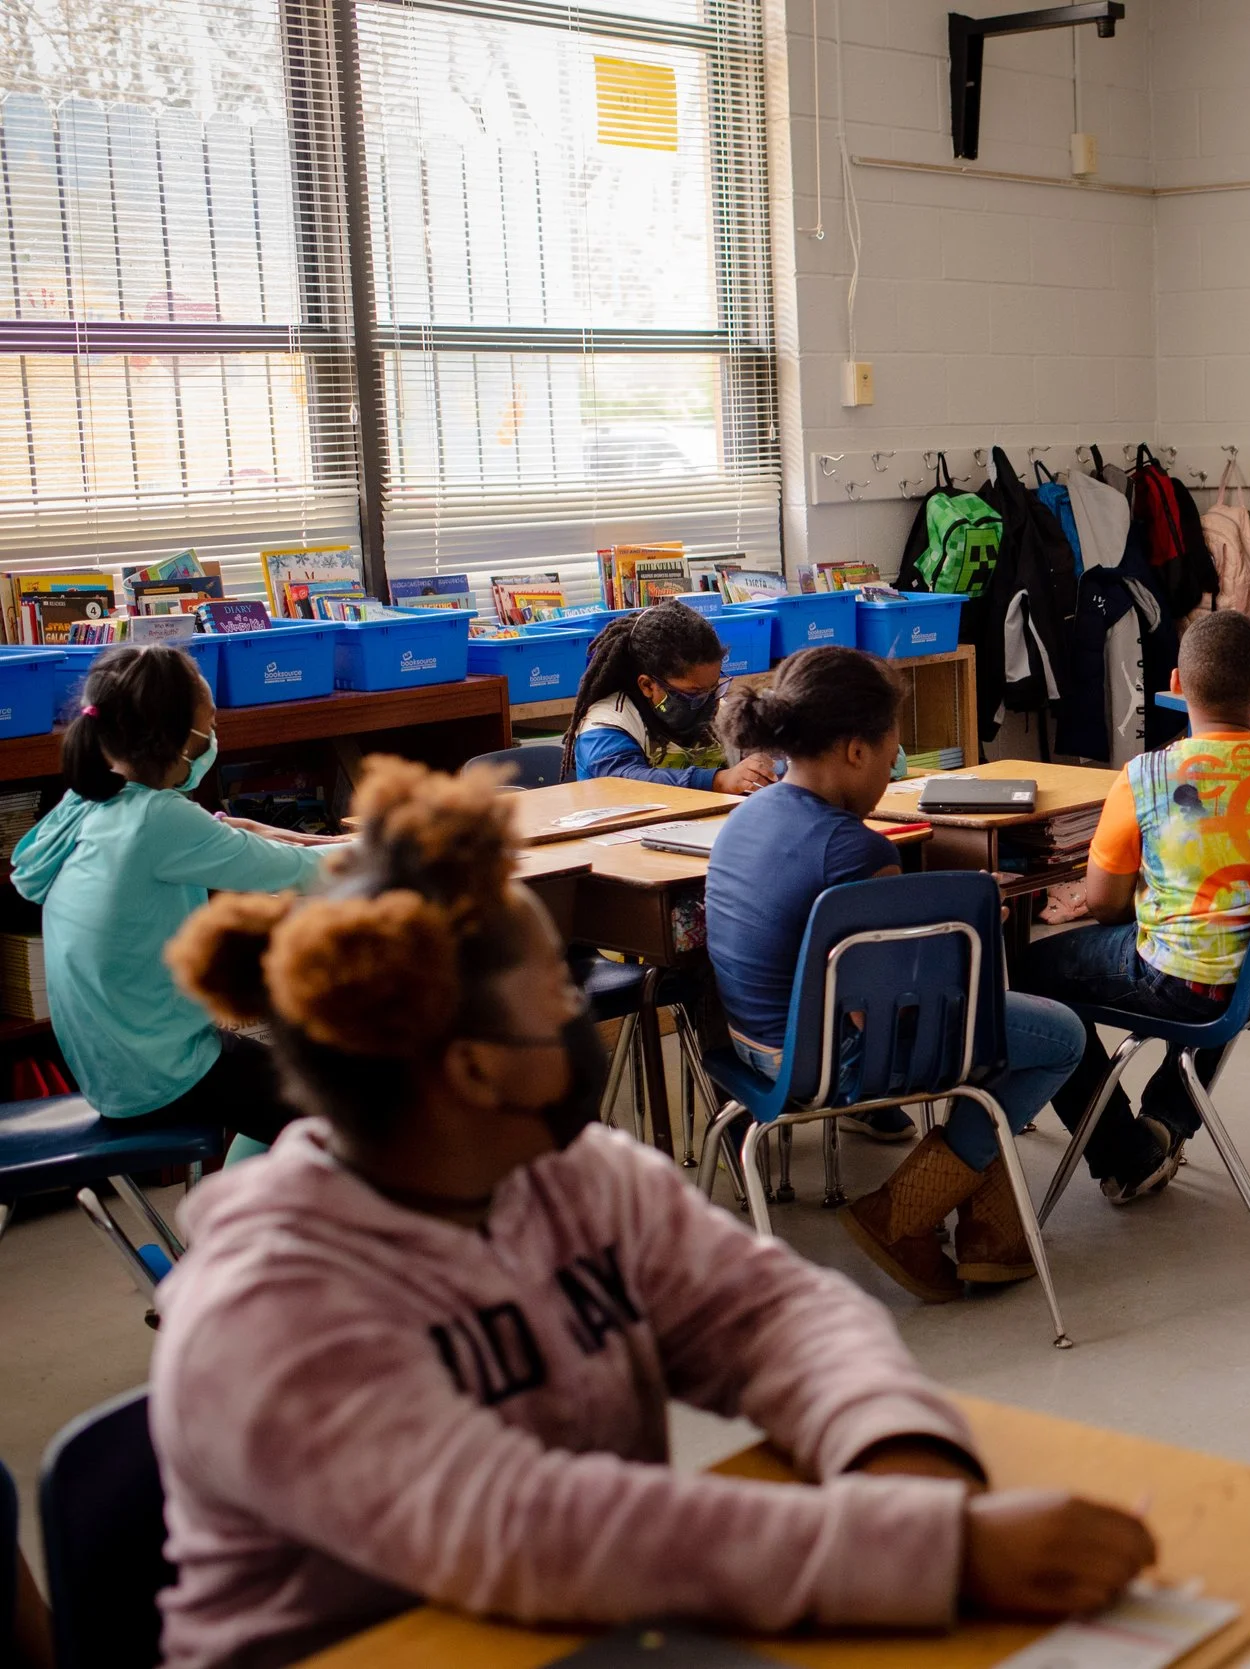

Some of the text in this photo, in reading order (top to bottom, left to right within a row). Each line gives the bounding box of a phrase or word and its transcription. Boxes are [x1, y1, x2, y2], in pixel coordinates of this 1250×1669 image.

[90, 606, 97, 616] 4
[223, 604, 252, 614] DIARY
[264, 670, 303, 679] booksource
